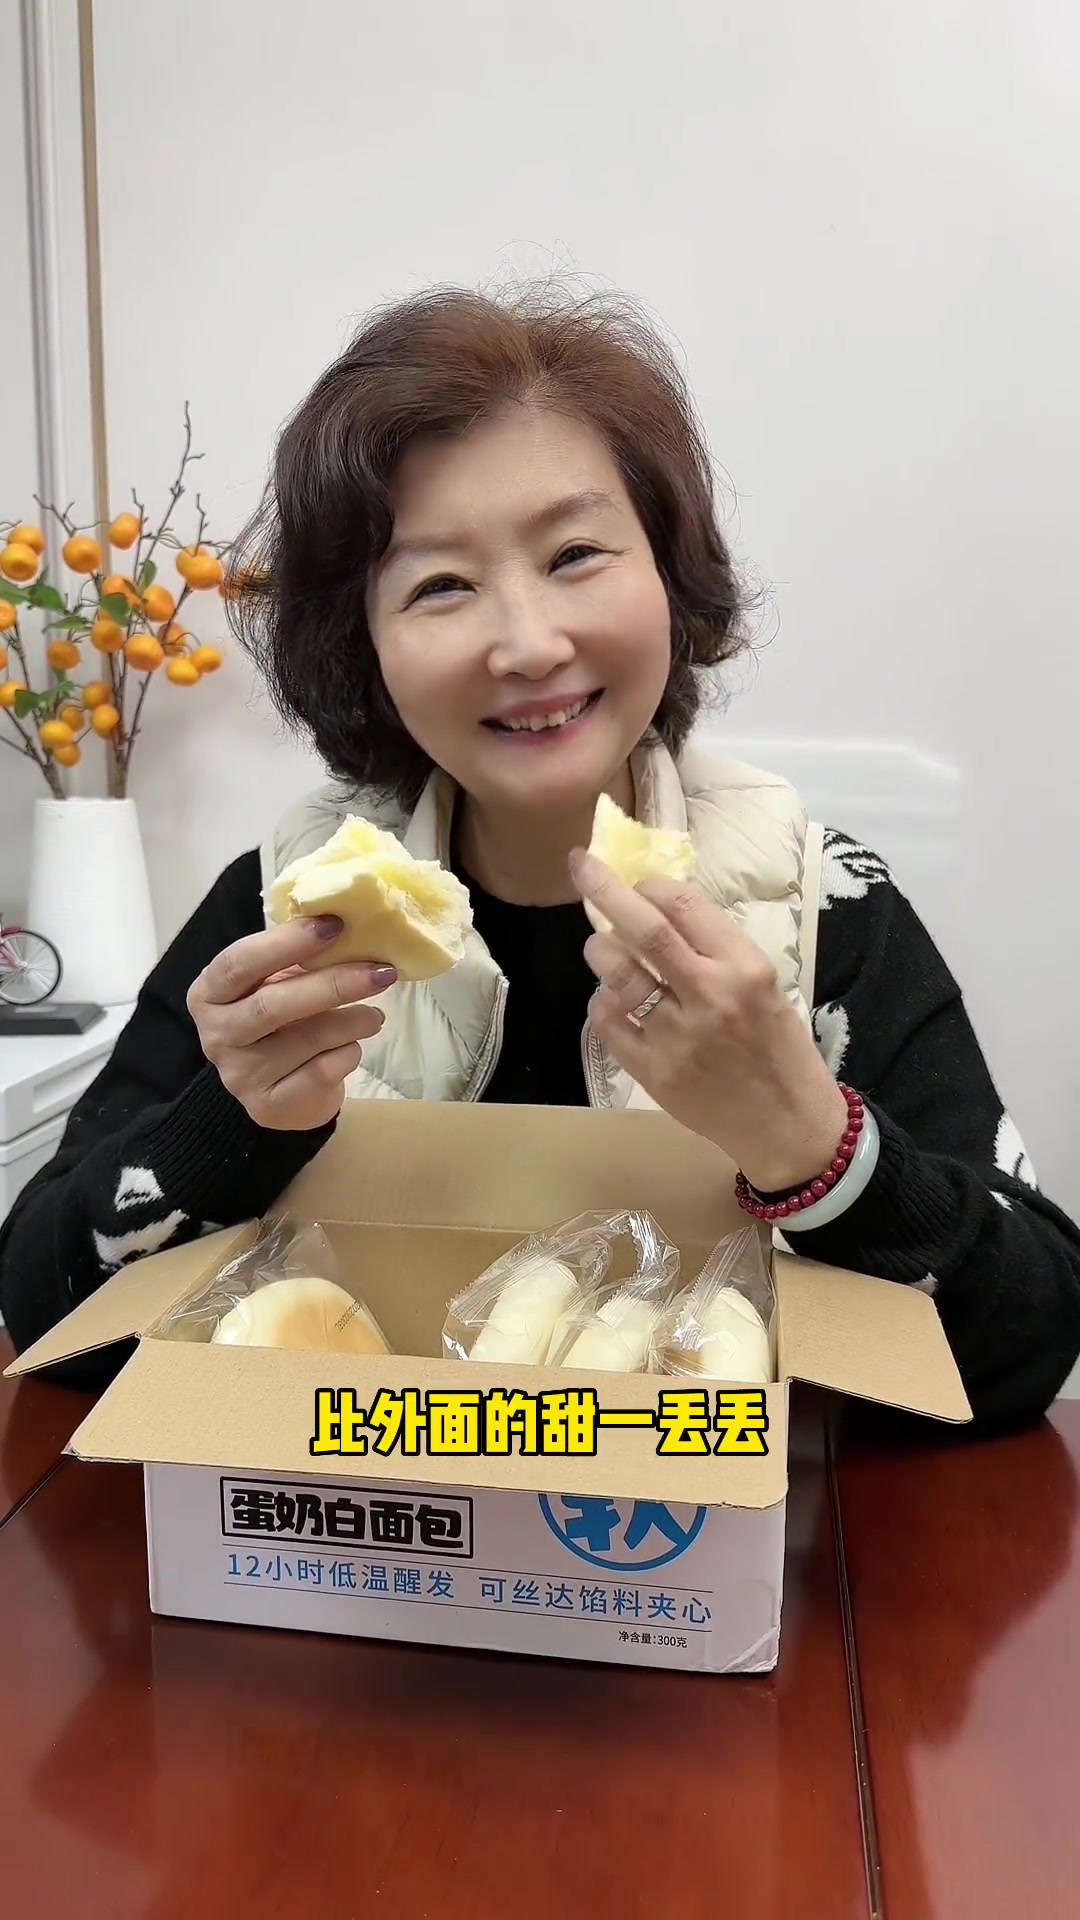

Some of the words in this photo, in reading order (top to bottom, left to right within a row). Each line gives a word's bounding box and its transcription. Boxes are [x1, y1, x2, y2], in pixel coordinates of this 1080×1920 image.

[230, 1488, 464, 1549] 蛋奶白面包
[228, 1553, 454, 1599] 12小时低温醒发
[479, 1573, 712, 1624] 可丝达馅料夹心
